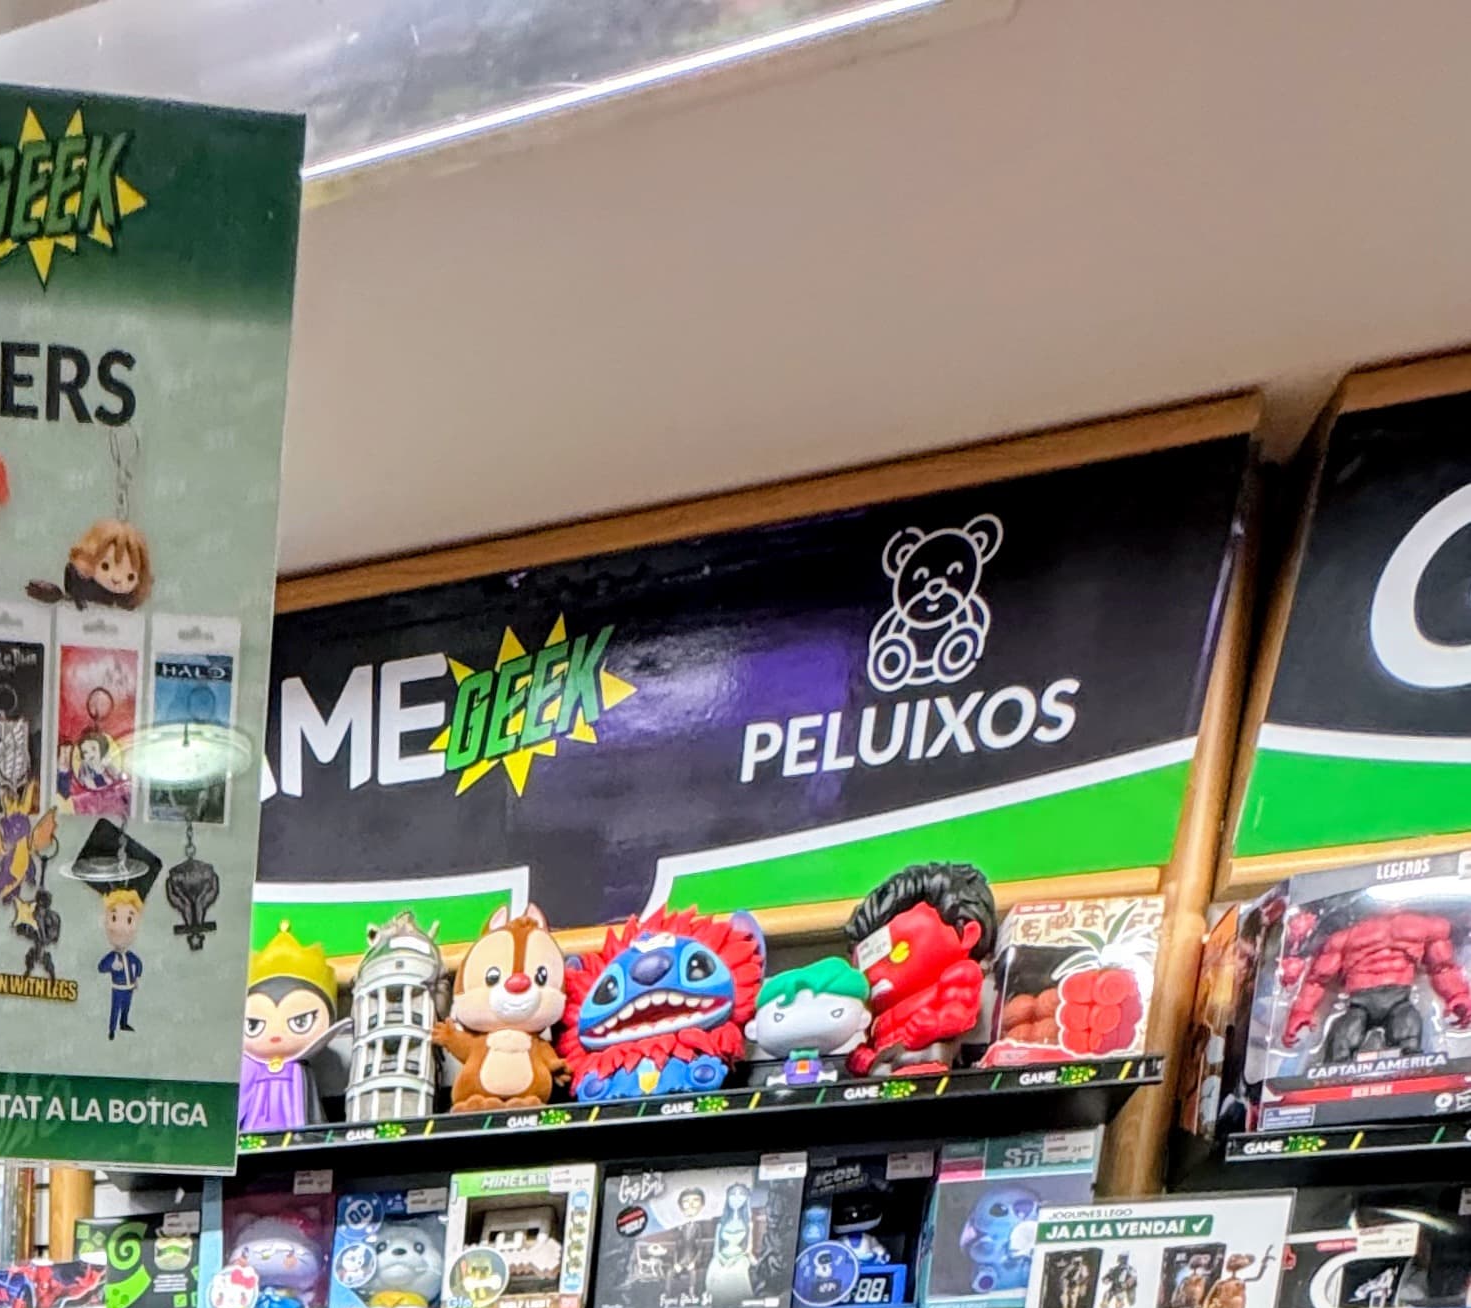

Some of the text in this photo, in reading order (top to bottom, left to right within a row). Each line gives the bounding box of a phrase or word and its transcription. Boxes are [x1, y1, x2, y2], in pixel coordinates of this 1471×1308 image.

[262, 622, 619, 800] ME GEEK
[740, 676, 1080, 786] PELUIXOS
[1375, 859, 1430, 881] LEGENDS
[1307, 1053, 1448, 1079] CAPTAIN AMERICA
[45, 1096, 66, 1121] A
[70, 1097, 104, 1123] LA
[108, 1097, 209, 1128] BOTIGA
[1045, 1226, 1071, 1240] JA
[1089, 1223, 1113, 1238] LA
[1114, 1218, 1186, 1236] VENDA!
